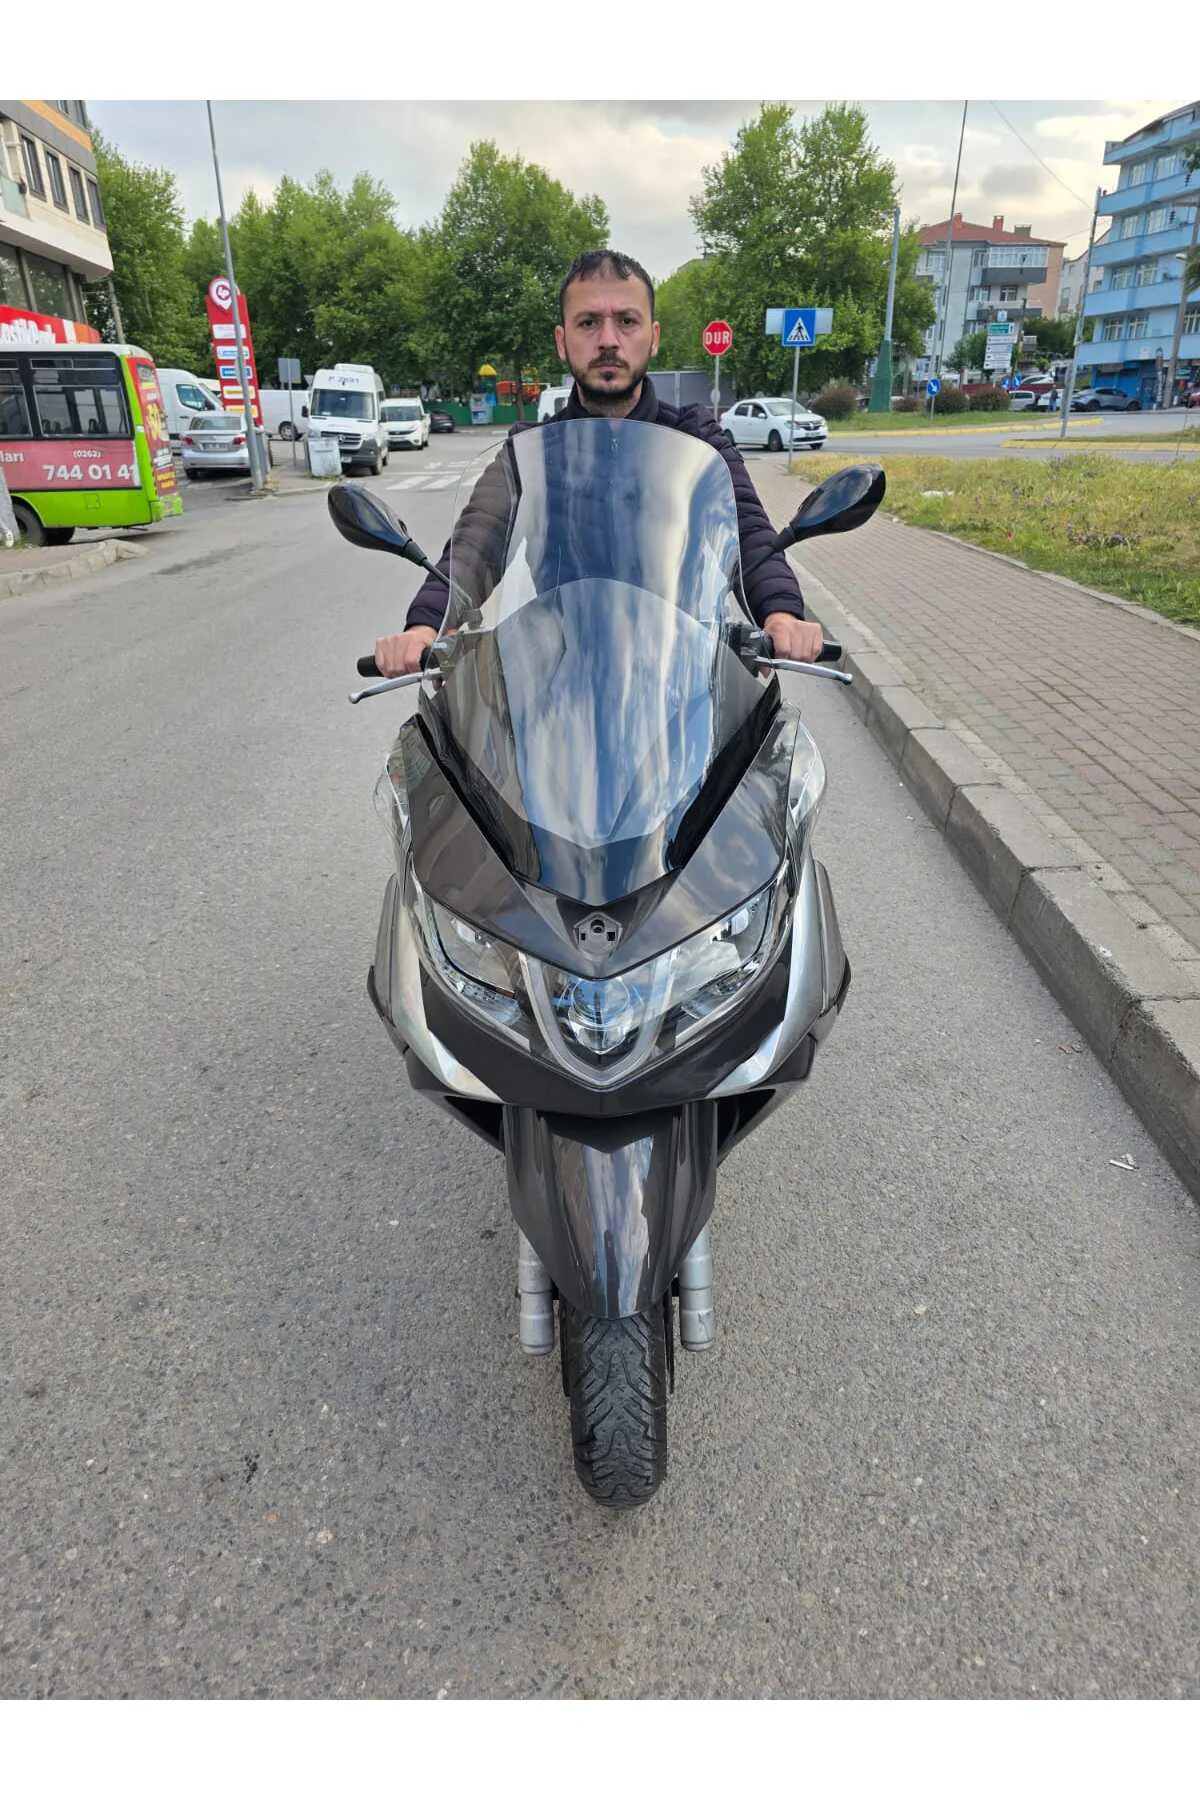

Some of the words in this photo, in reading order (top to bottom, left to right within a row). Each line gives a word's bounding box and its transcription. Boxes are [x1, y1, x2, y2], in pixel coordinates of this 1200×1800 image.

[705, 331, 730, 345] DUR
[73, 449, 102, 458] (0262)
[42, 464, 83, 480] 744
[88, 463, 112, 480] 01
